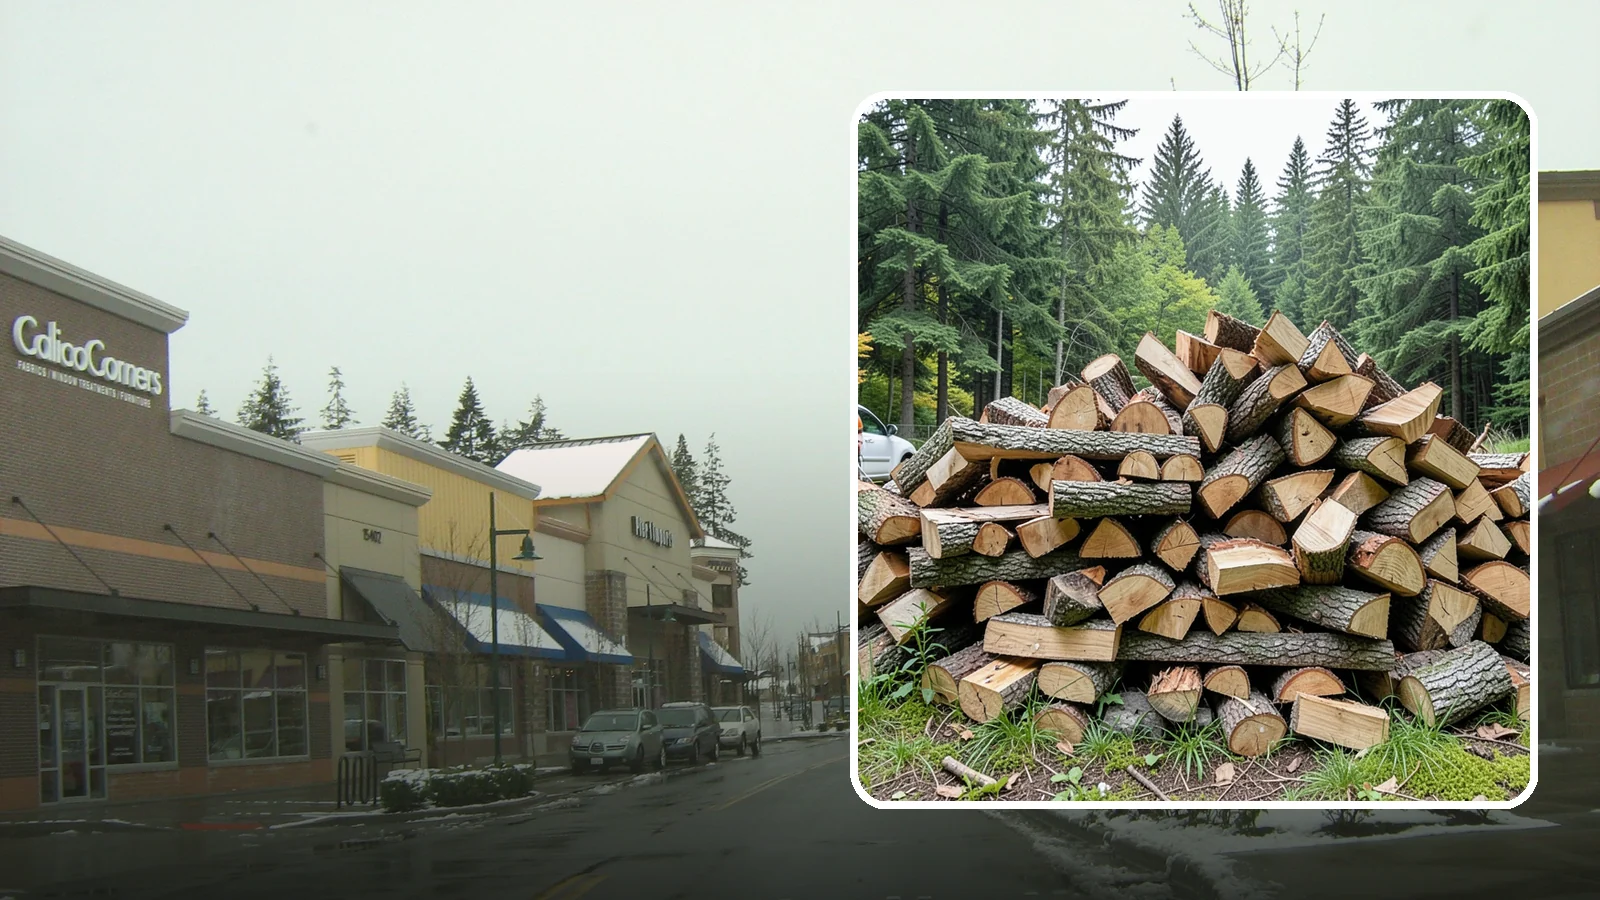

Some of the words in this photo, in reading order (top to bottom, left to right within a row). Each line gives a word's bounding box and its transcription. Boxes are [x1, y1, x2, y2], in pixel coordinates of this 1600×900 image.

[16, 360, 47, 378] FABRICS
[52, 370, 78, 387] WINDOW
[79, 378, 117, 399] TREATMENTS
[119, 391, 151, 409] FURNITURE
